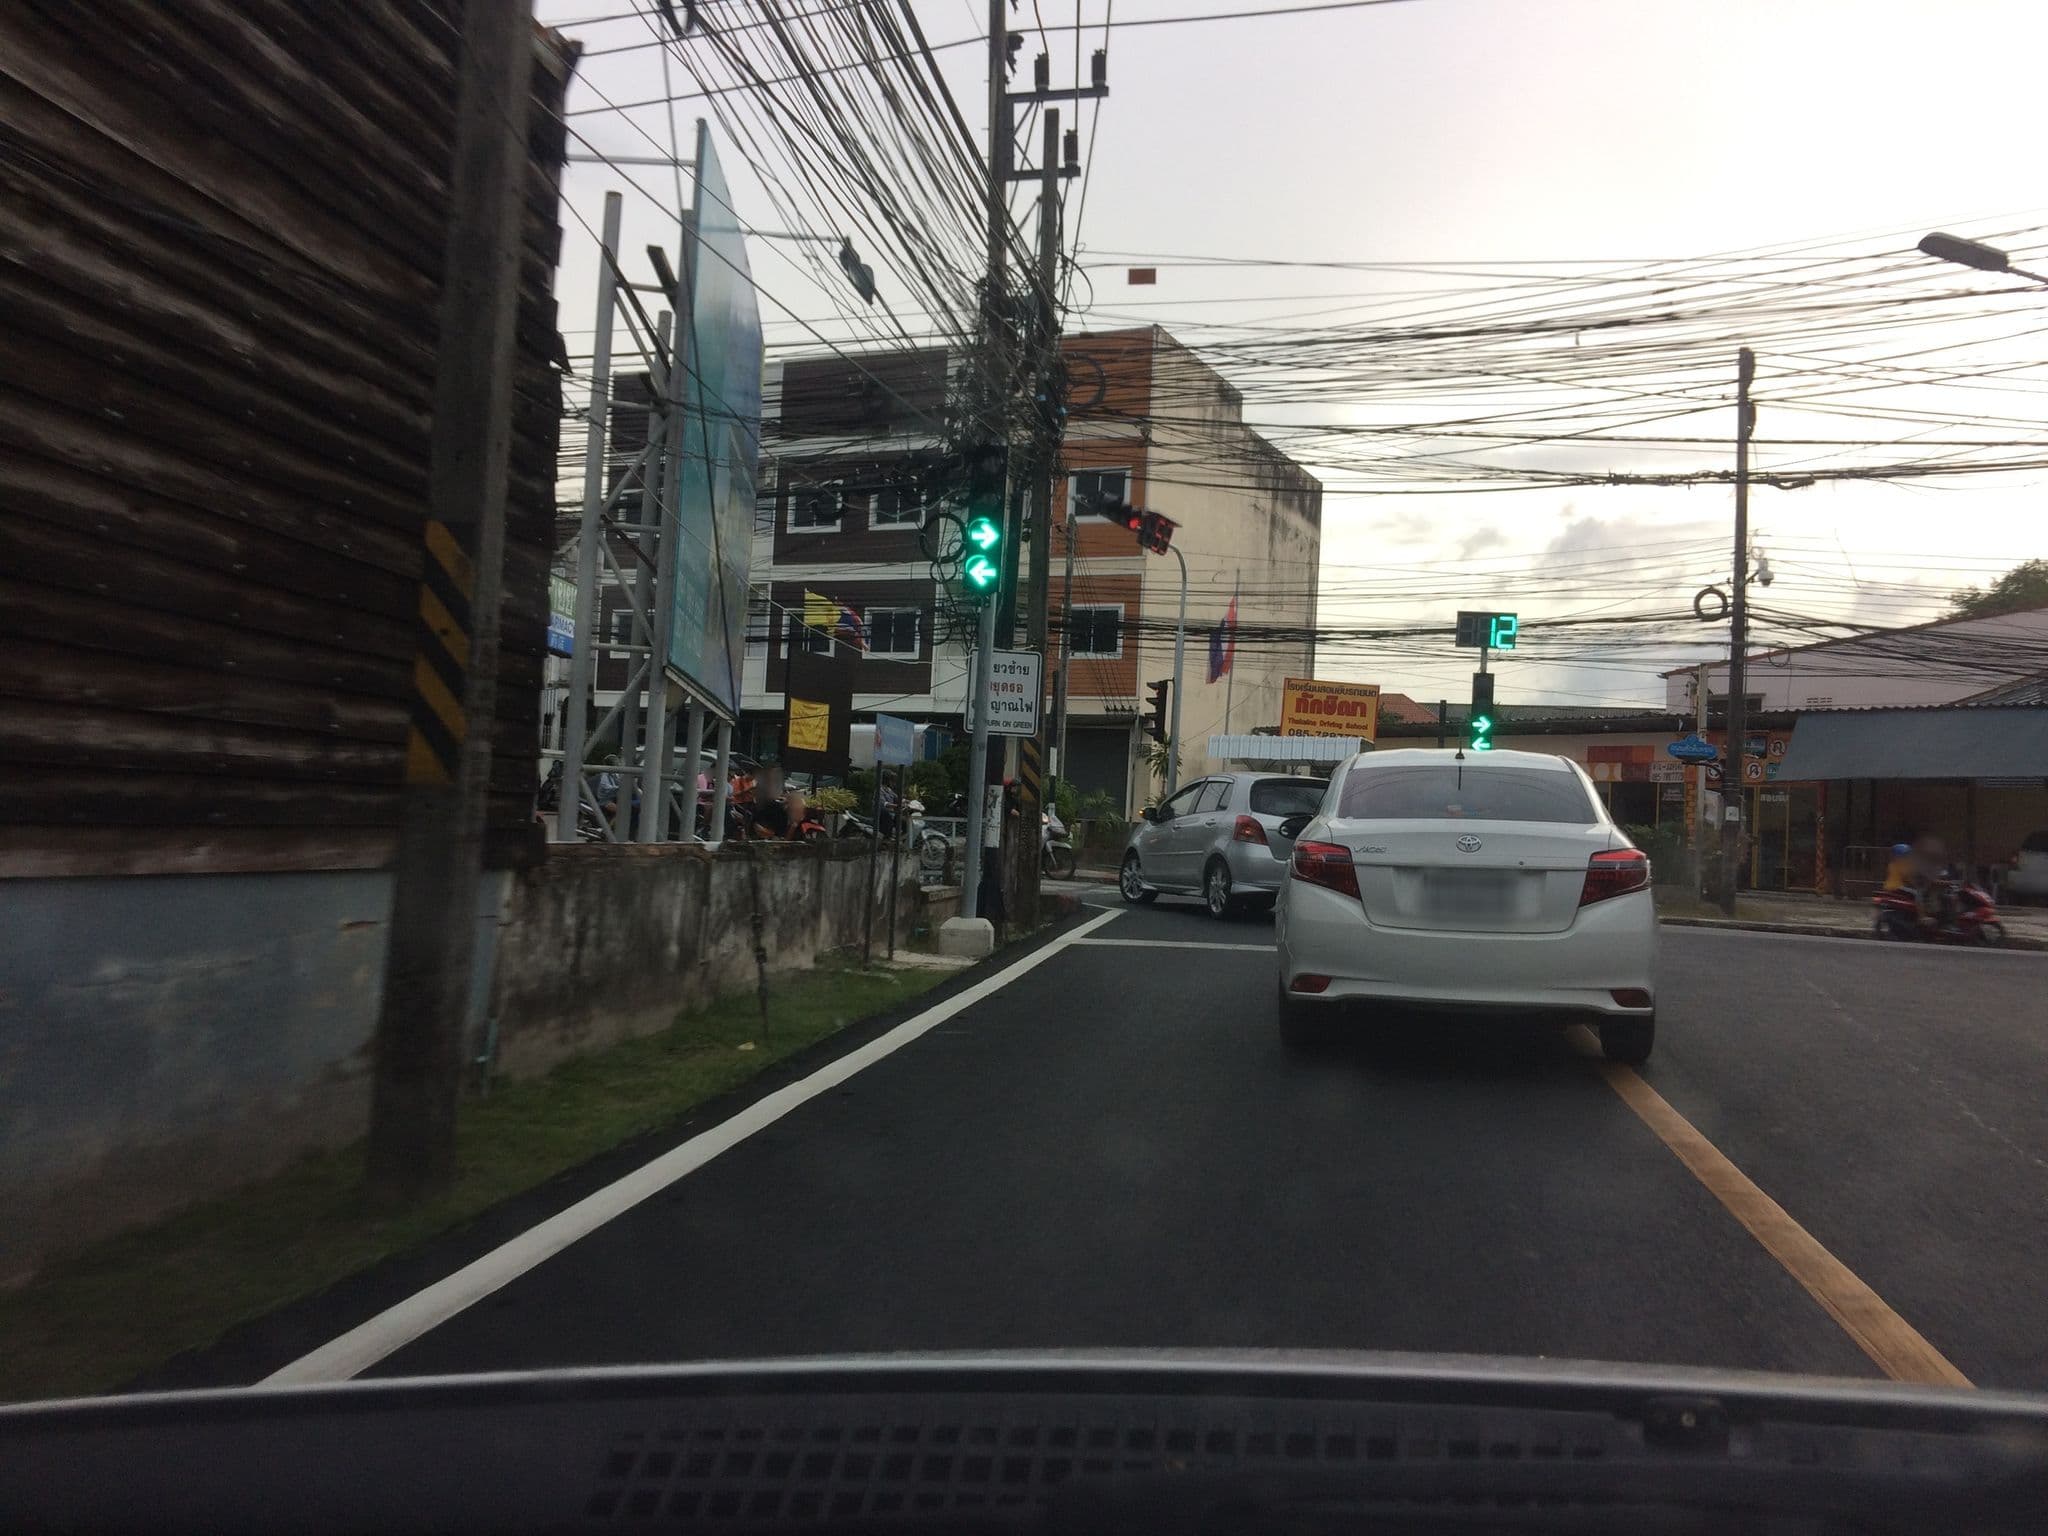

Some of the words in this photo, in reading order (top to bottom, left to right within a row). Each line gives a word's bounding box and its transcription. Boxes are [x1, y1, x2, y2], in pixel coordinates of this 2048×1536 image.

[1490, 616, 1516, 648] 12
[993, 660, 1030, 675] ยวซ้าย
[972, 698, 1033, 713] ญาณไฟ
[986, 719, 1001, 727] URN
[1002, 720, 1012, 728] ON
[1013, 721, 1033, 729] GREEN
[1320, 720, 1343, 729] Driving
[1346, 722, 1368, 730] School
